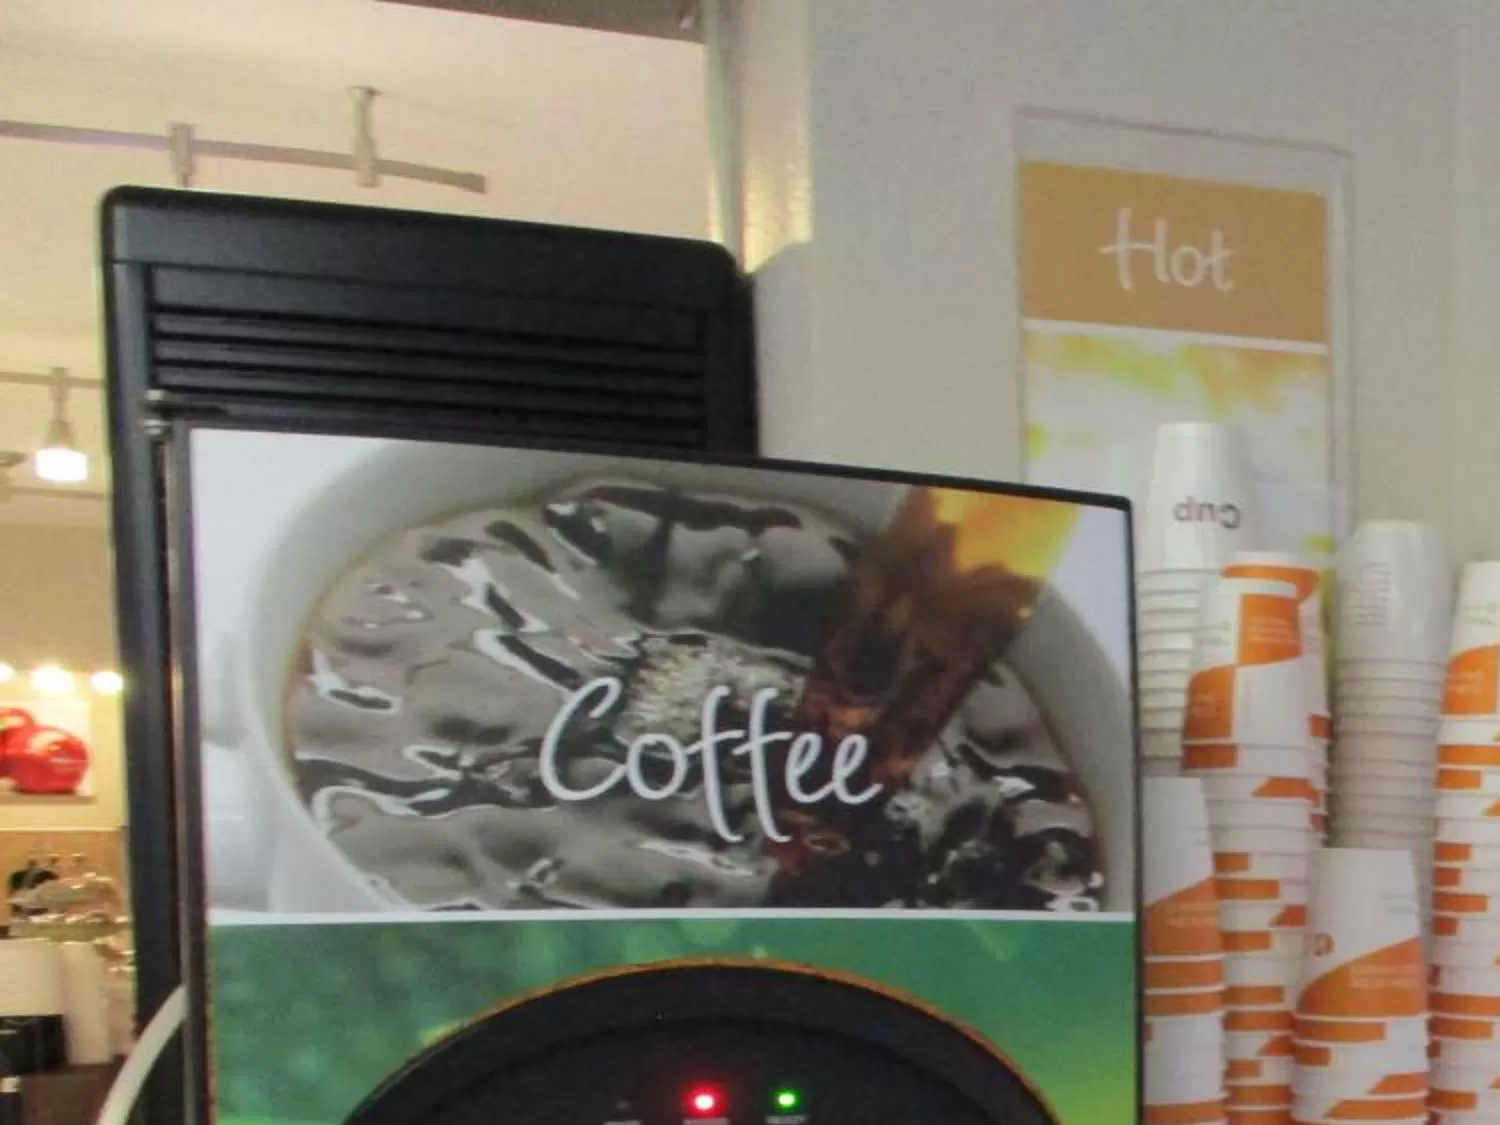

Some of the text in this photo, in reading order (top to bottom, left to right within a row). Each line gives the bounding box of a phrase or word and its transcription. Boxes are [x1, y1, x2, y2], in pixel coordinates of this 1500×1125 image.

[1098, 207, 1236, 291] Hot
[1172, 495, 1241, 529] Cup
[538, 677, 883, 843] Coffee
